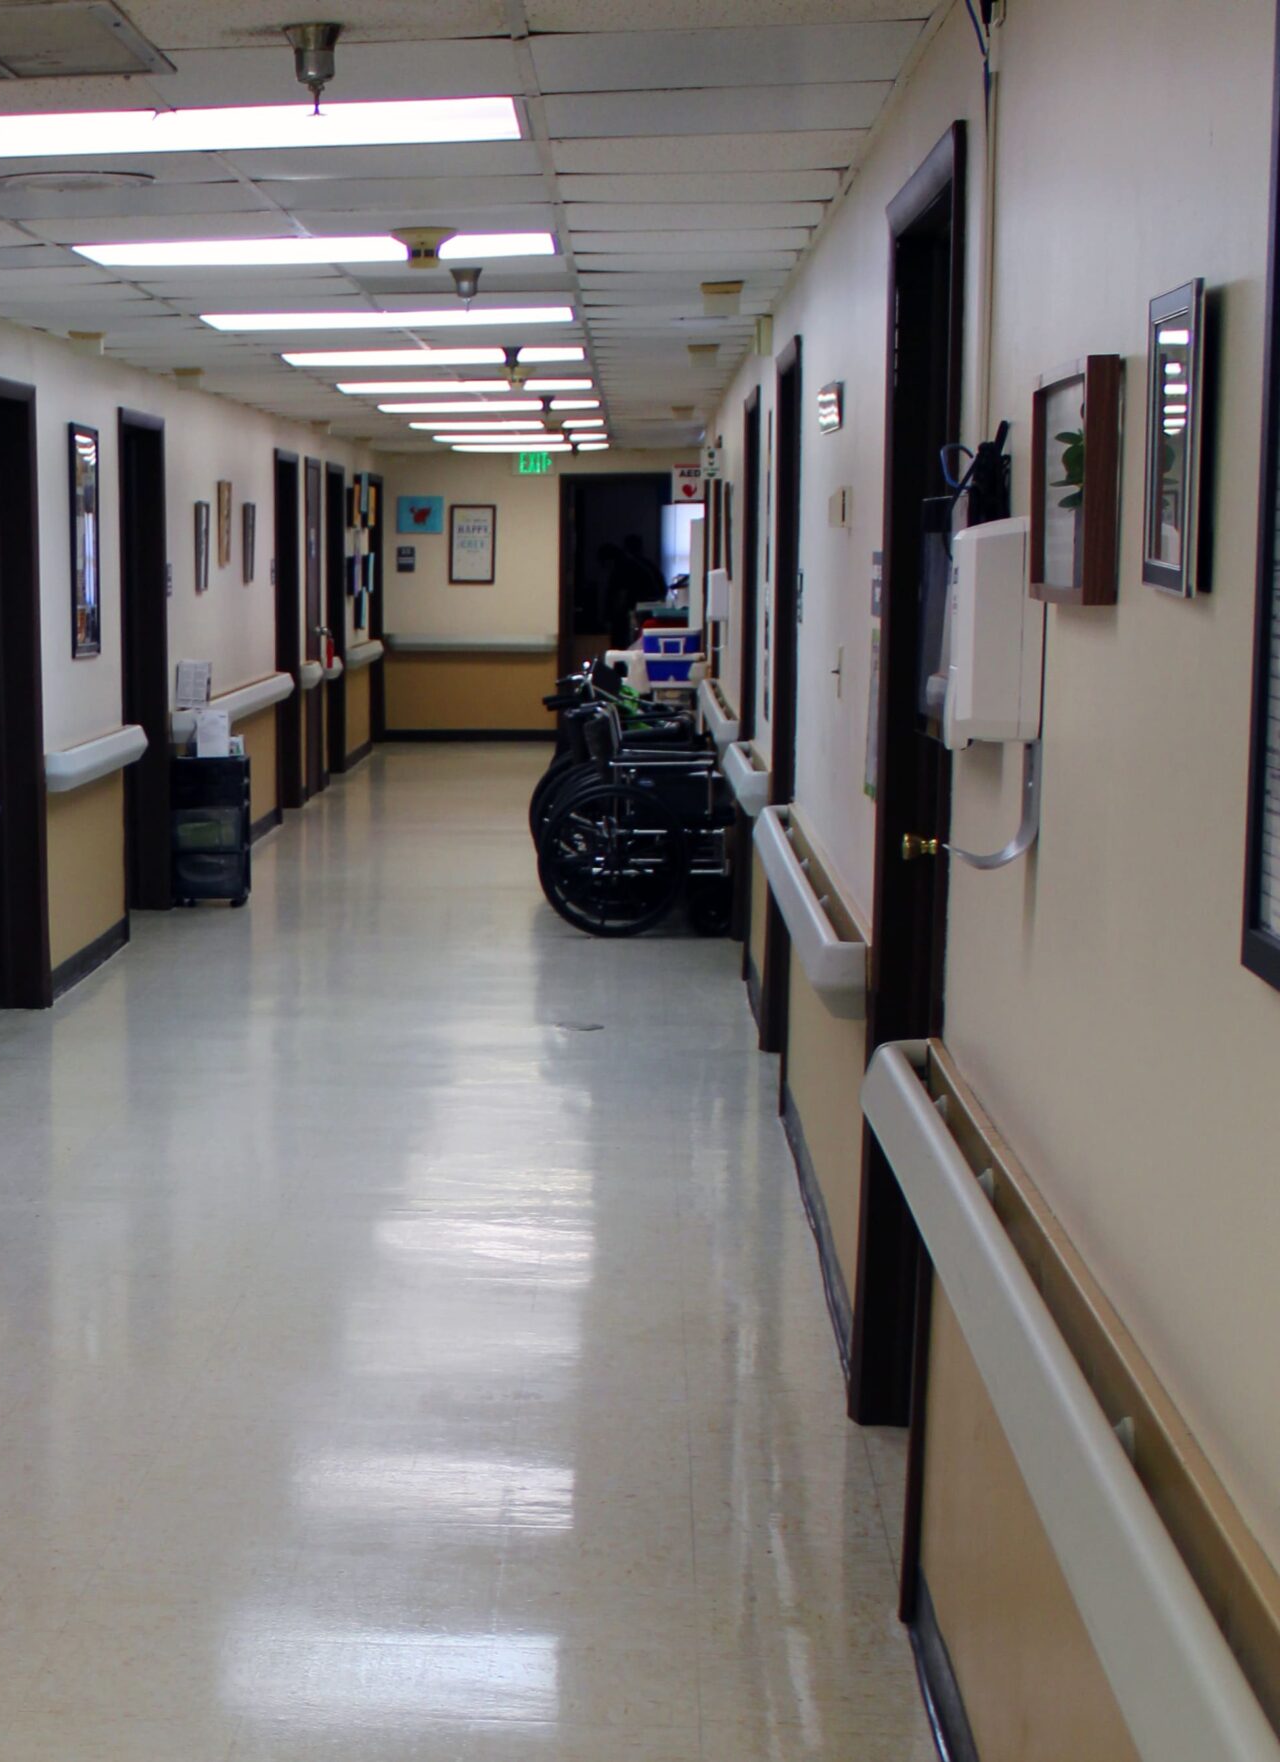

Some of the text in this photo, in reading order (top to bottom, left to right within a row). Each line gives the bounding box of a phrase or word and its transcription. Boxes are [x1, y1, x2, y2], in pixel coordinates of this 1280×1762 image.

[520, 452, 548, 475] EXIT
[679, 469, 701, 479] AED
[457, 525, 489, 535] HAPPY
